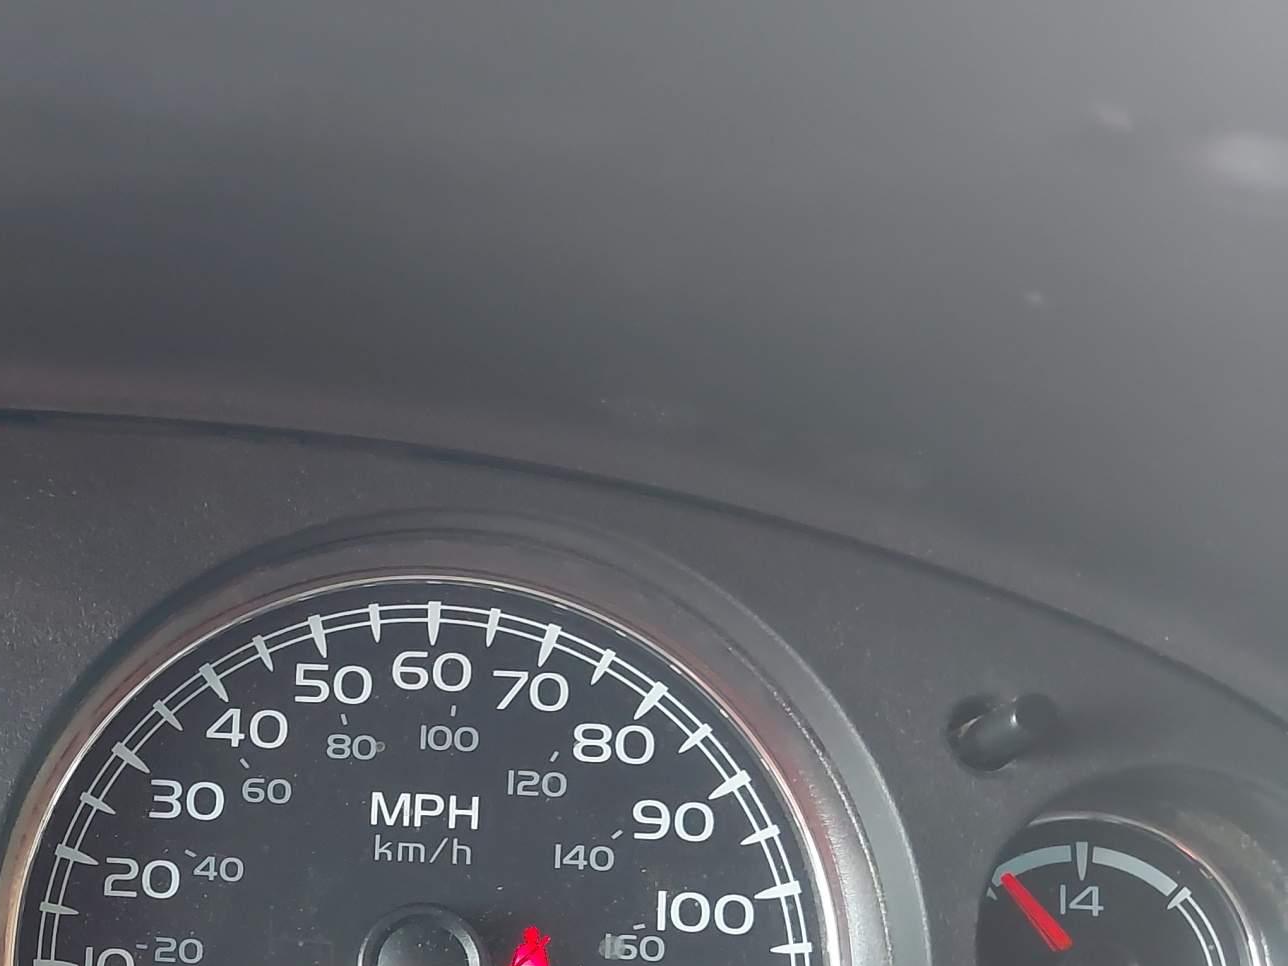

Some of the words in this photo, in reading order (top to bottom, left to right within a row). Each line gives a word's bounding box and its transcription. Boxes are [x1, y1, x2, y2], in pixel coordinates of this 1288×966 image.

[294, 663, 373, 705] 50
[392, 651, 472, 692] 60
[492, 670, 569, 712] 70
[206, 708, 288, 749] 40
[326, 733, 372, 760] 80
[420, 724, 479, 752] 100
[572, 723, 655, 766] 80
[149, 779, 225, 821] 30
[242, 777, 292, 804] 60
[507, 769, 567, 798] 120
[370, 791, 480, 830] MPH
[632, 799, 715, 842] 90
[193, 856, 244, 882] 40
[373, 837, 472, 865] km/h
[554, 843, 615, 871] 140
[104, 857, 180, 899] 20
[657, 890, 755, 935] 100
[1060, 884, 1105, 917] 14
[154, 936, 204, 964] 20
[604, 933, 665, 962] 160
